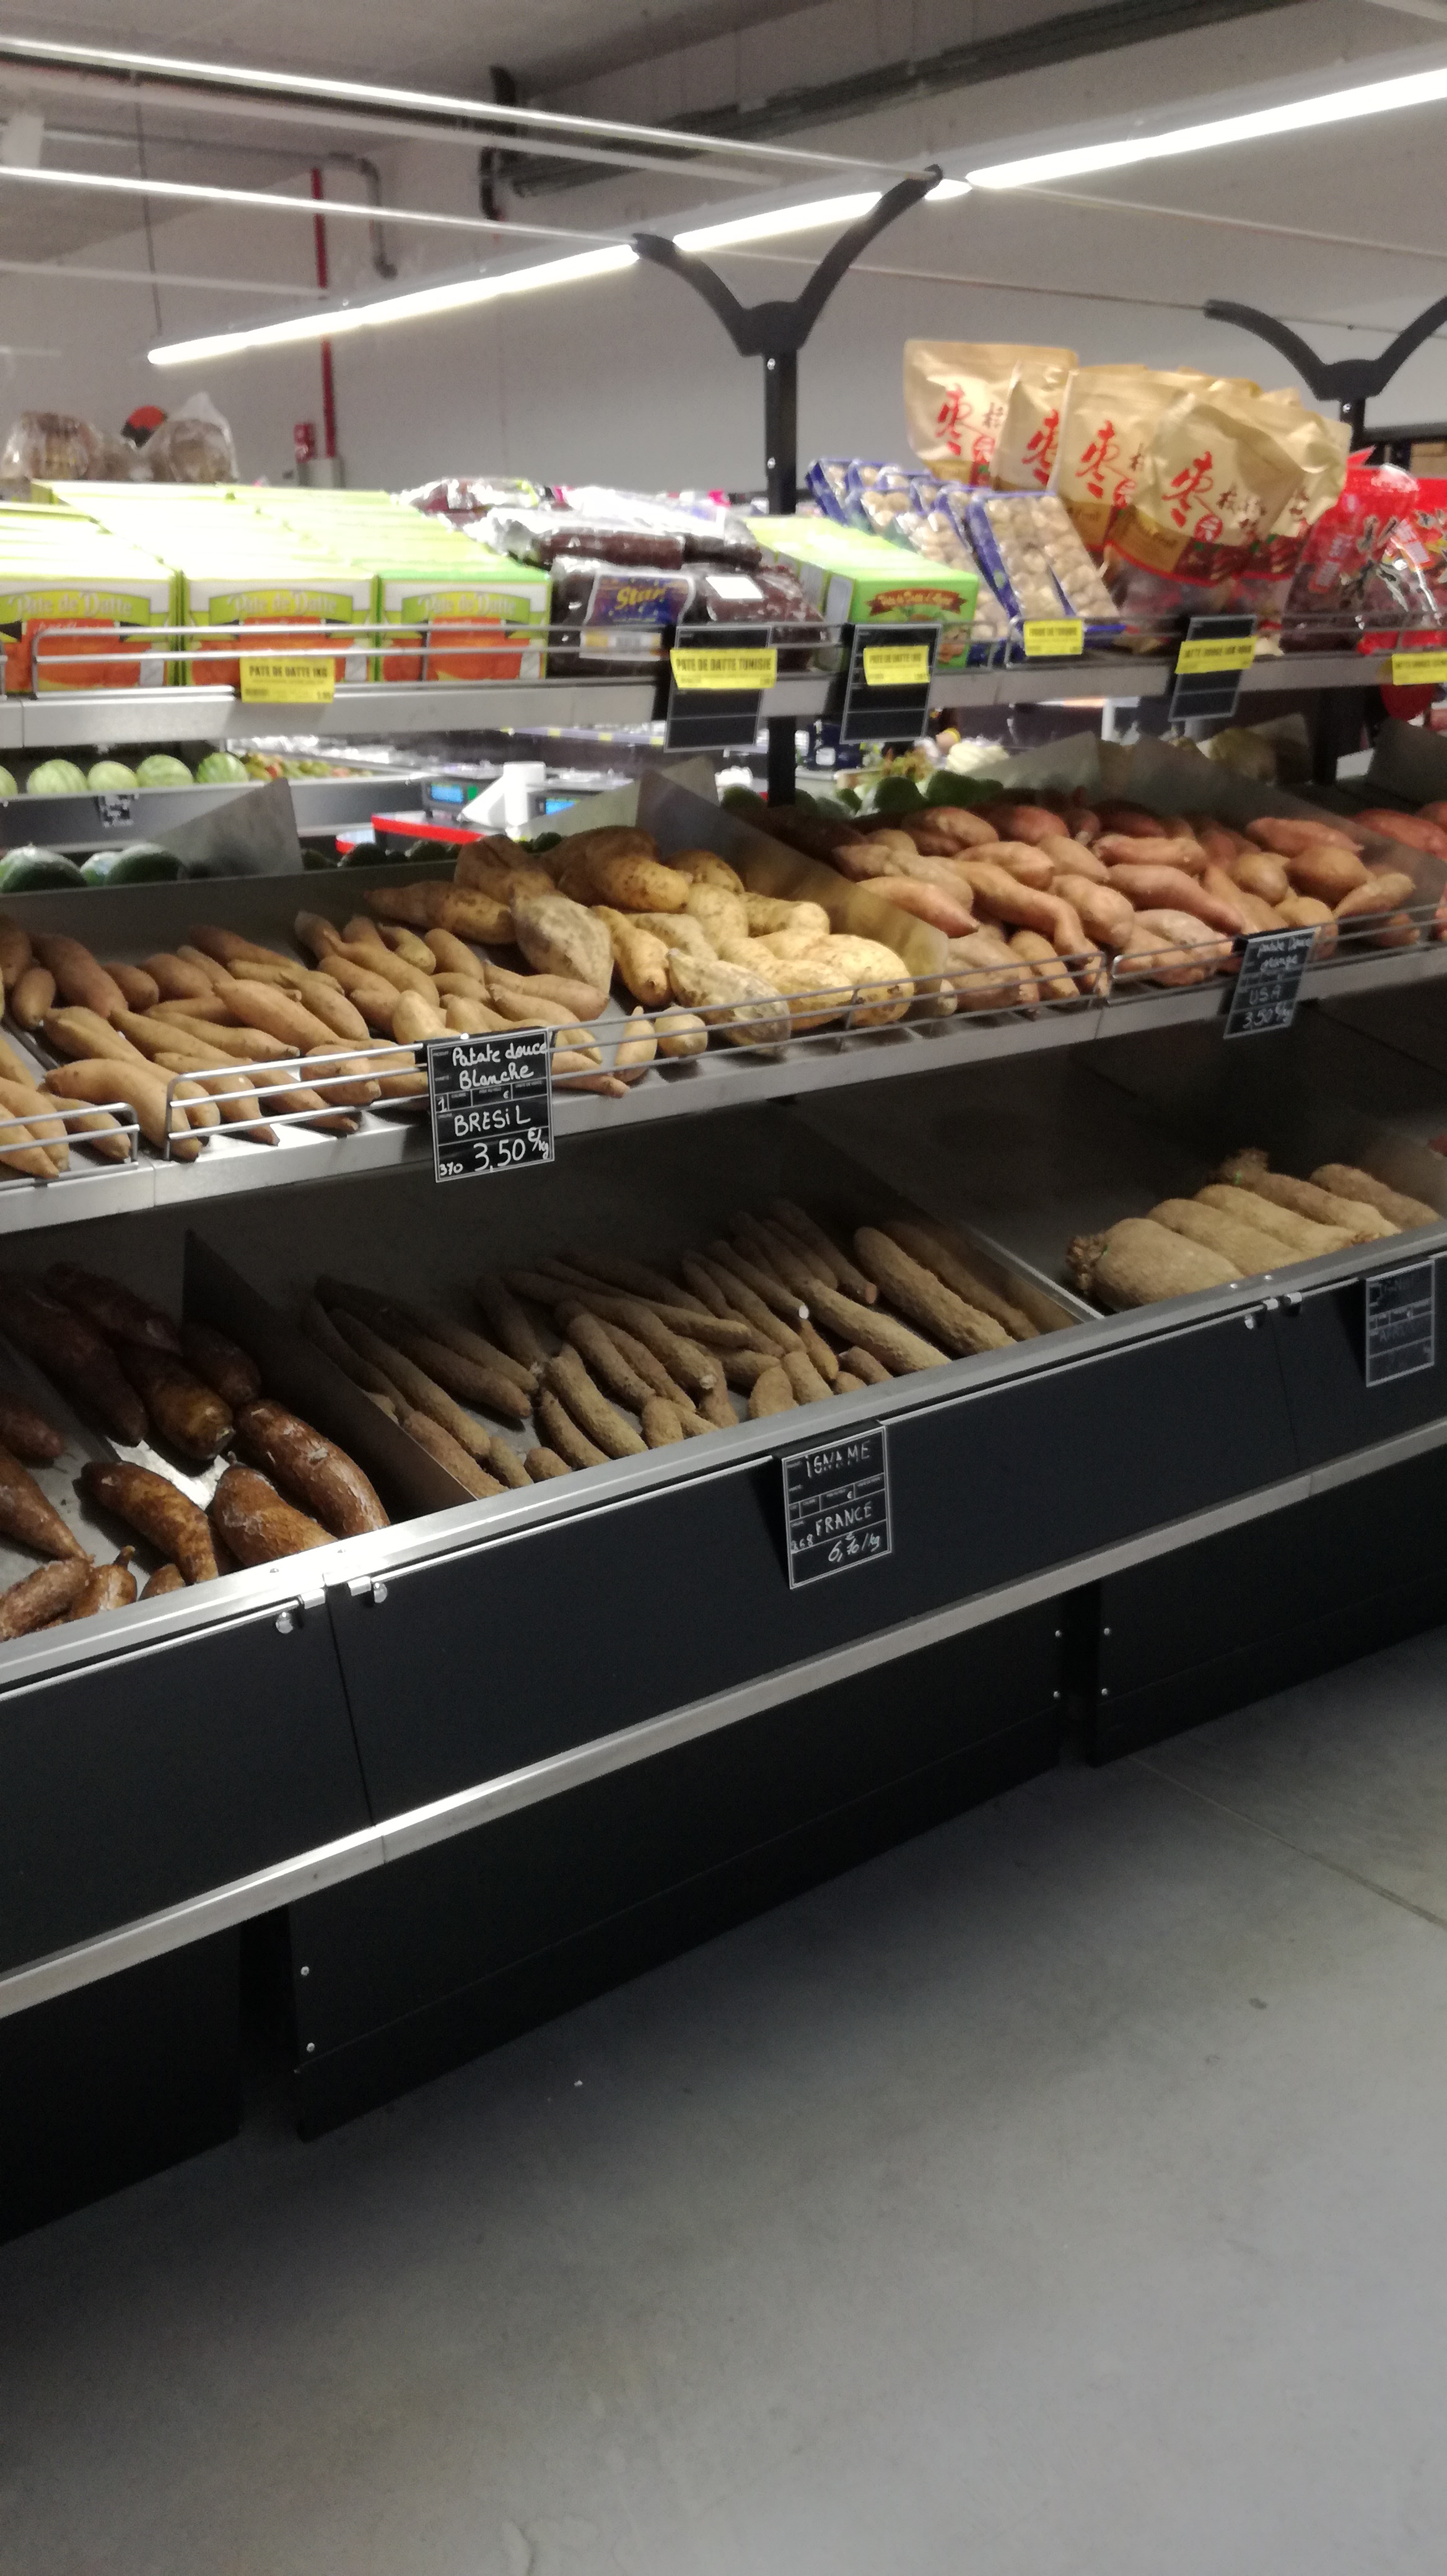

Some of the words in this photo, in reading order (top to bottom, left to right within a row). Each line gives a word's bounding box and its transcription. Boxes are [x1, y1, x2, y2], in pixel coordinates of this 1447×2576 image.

[284, 666, 310, 678] DATTE
[697, 658, 708, 671] DE
[710, 658, 736, 671] DATTE
[739, 658, 771, 671] TUNISIE
[452, 1043, 501, 1066] Patate
[505, 1042, 547, 1060] douce
[459, 1062, 534, 1090] Blanche
[816, 1501, 872, 1536] FRANCE
